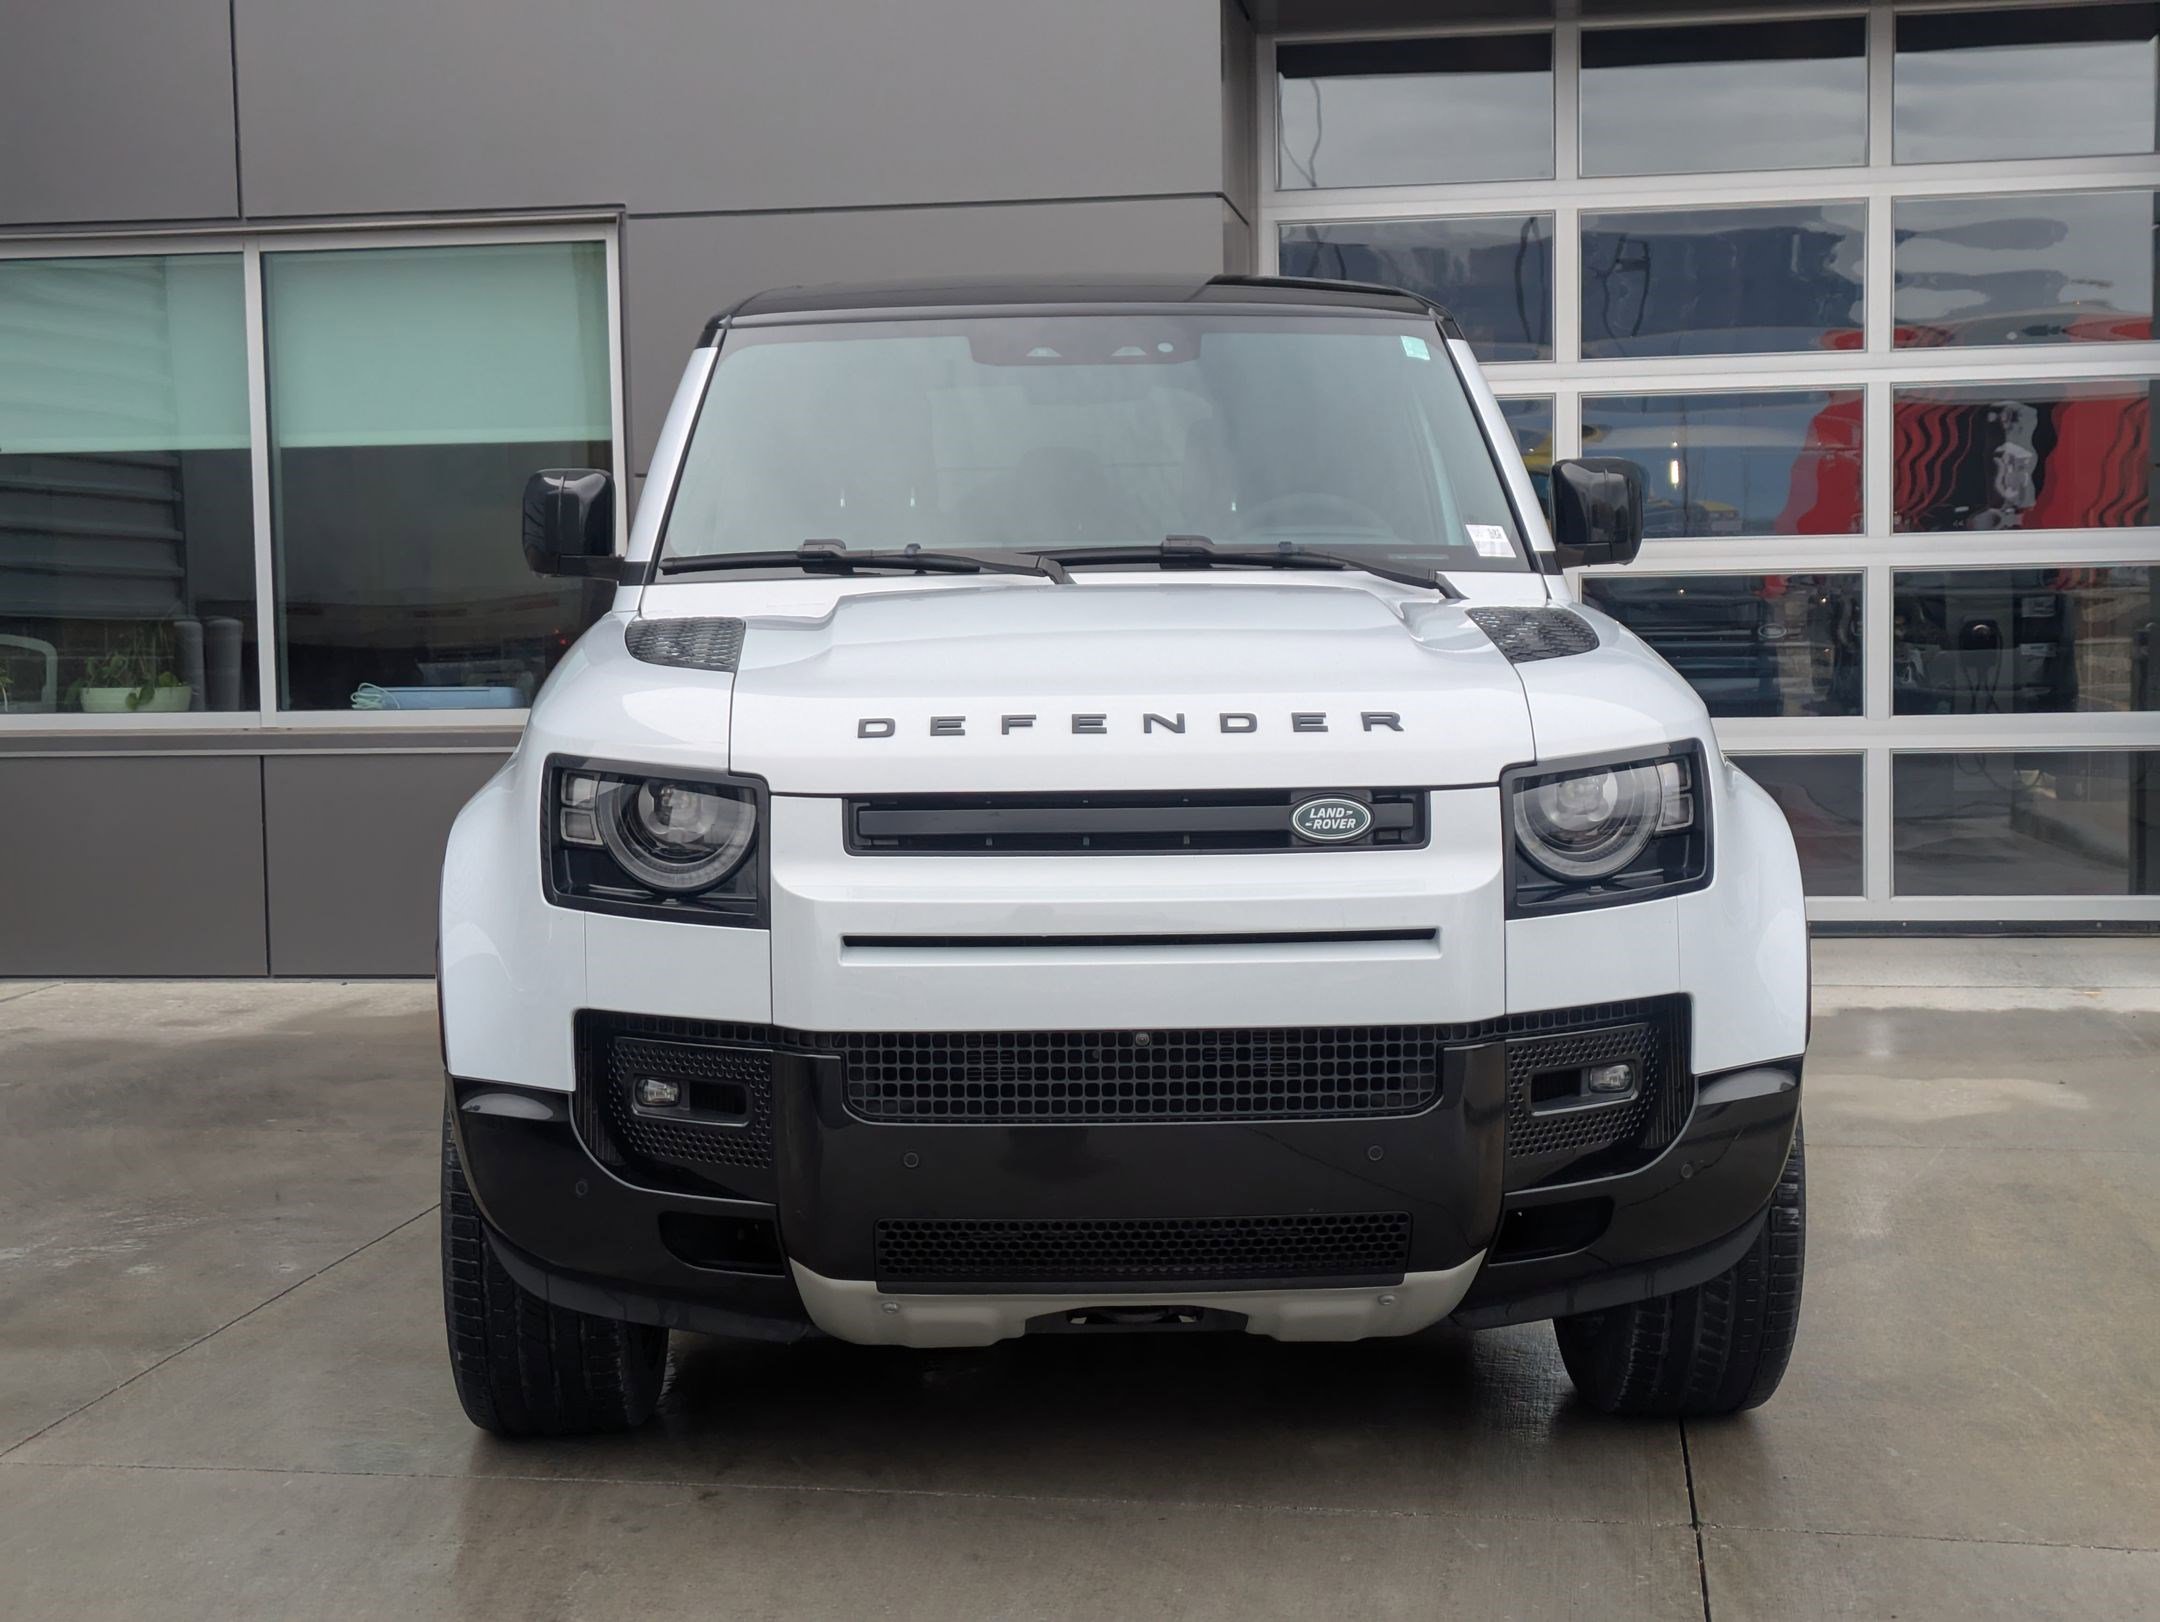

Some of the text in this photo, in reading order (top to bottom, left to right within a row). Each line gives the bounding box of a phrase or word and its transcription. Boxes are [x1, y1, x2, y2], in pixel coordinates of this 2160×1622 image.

[857, 711, 1405, 738] DEFENDER
[1309, 807, 1345, 819] LAND
[1312, 818, 1356, 830] ROVER
